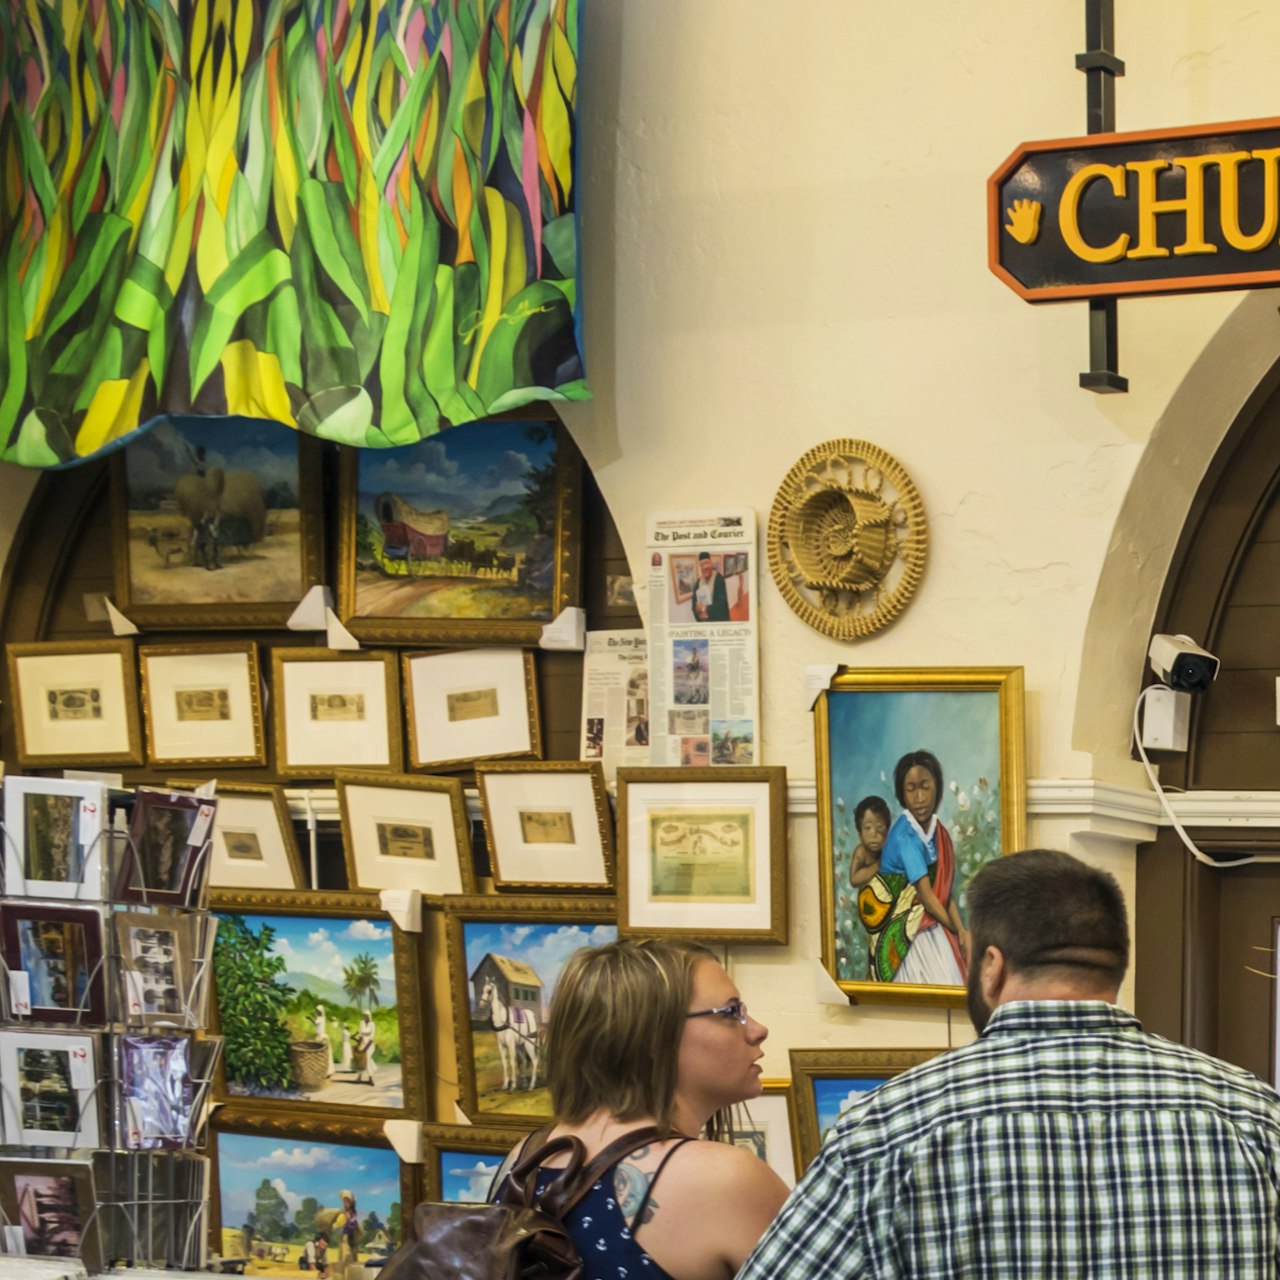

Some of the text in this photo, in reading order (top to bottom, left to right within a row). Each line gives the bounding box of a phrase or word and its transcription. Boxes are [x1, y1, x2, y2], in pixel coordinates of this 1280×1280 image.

[654, 529, 745, 542] The Post and Courier
